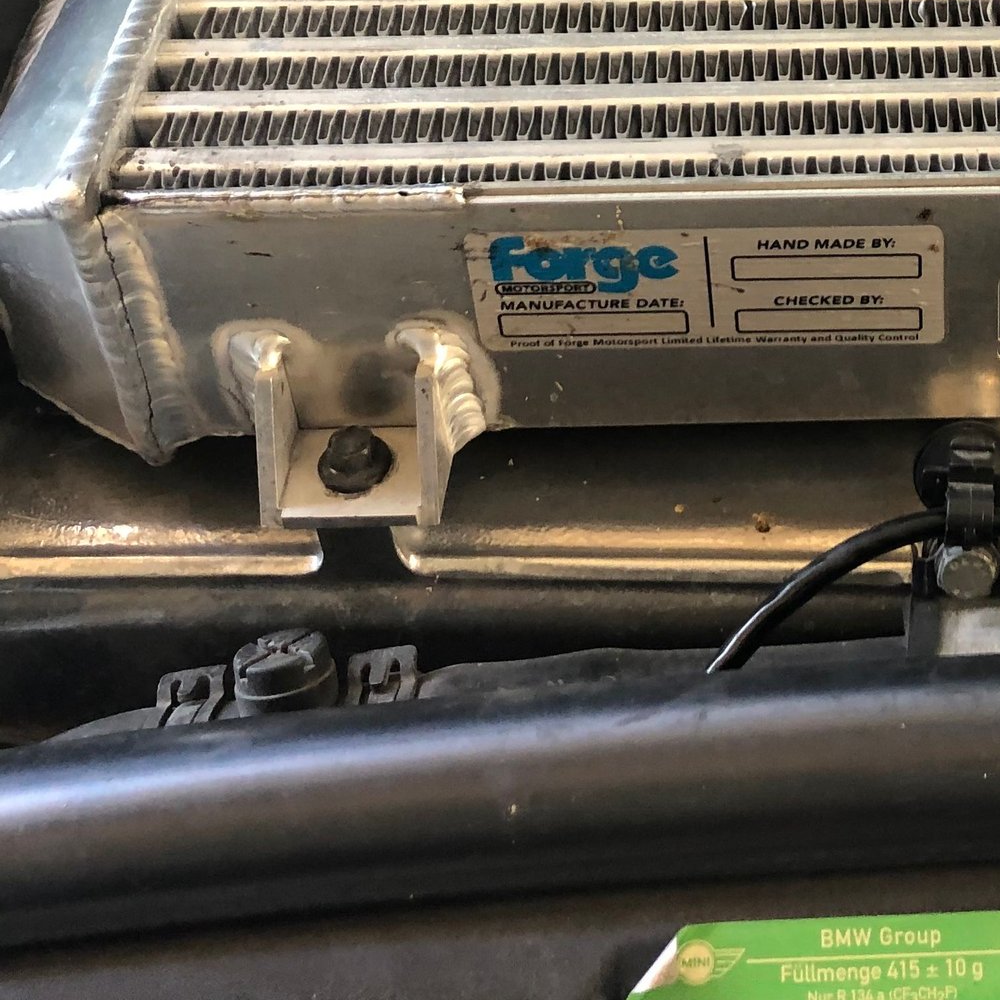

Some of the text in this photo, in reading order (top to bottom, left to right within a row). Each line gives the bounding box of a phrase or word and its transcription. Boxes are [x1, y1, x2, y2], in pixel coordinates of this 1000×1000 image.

[757, 237, 896, 251] HAND MADE BY:
[501, 282, 591, 294] MOTORSPORT
[500, 297, 685, 311] MANUFACTURE DATE:
[773, 294, 885, 307] CHECKED BY:
[510, 331, 919, 348] Proof of Forge Motorsport Limited Lifetime Warranty and Quality Control
[820, 926, 942, 948] BMW Group
[681, 956, 711, 969] MINI
[780, 963, 882, 985] Füllmenge
[887, 959, 920, 979] 415
[945, 957, 966, 977] 10
[971, 961, 984, 980] g
